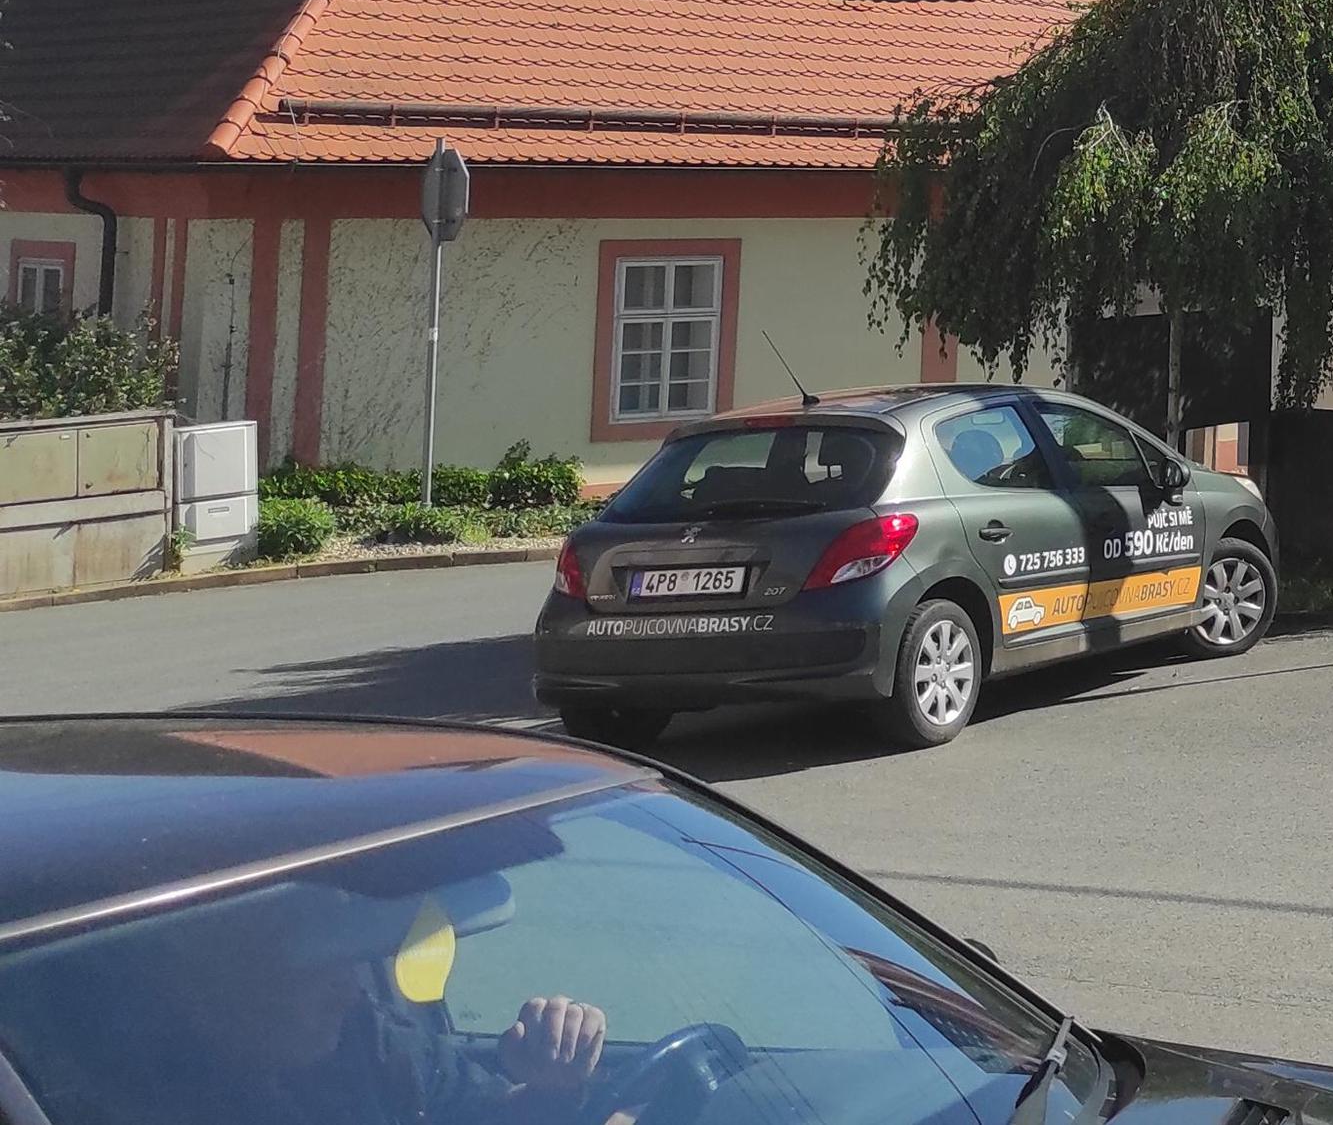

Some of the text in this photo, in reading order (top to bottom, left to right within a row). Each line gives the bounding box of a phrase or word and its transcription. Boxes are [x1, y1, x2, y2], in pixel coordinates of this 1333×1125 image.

[1169, 511, 1178, 527] SI
[1178, 506, 1193, 526] MĚ
[1104, 530, 1195, 559] OD 590 Kč/den
[1019, 546, 1086, 572] 725 756 333
[645, 569, 736, 593] 4P8 1265
[764, 586, 787, 596] 207
[586, 615, 775, 636] AUTOPUJCOVNABRASY.CZ
